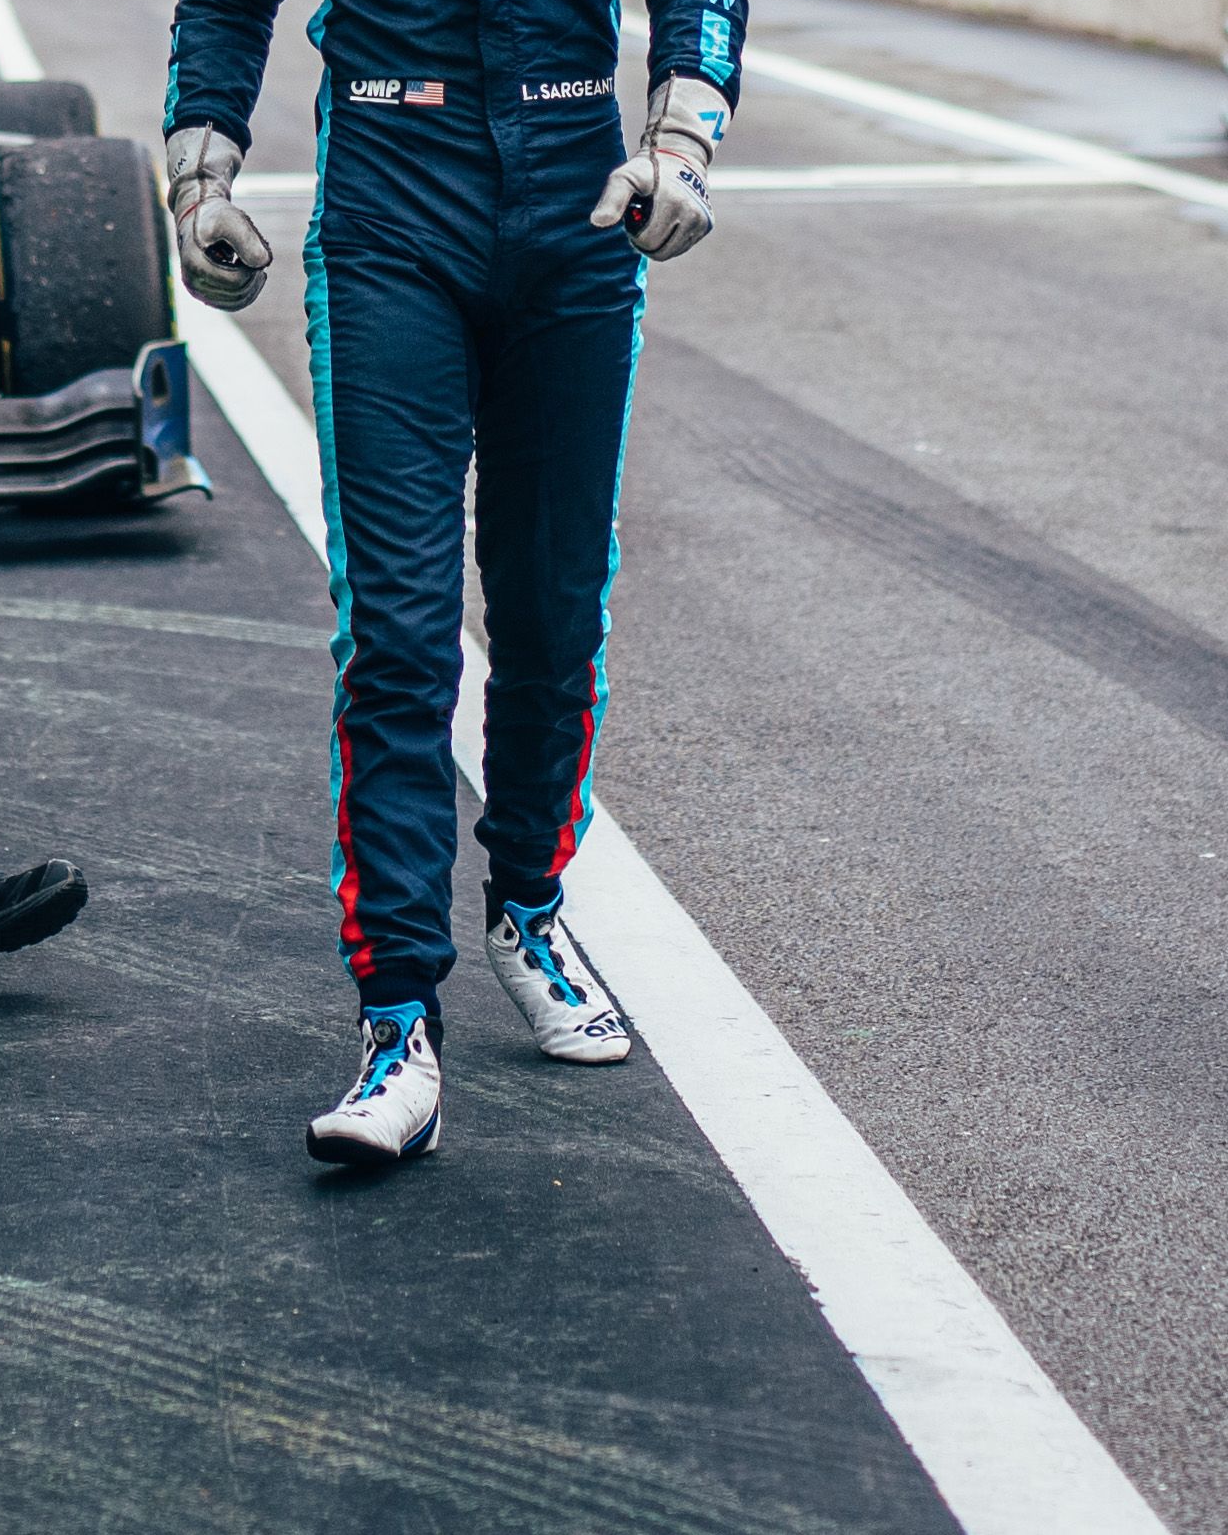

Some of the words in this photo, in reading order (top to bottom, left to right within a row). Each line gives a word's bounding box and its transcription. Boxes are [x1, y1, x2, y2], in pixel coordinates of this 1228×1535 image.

[350, 78, 402, 99] OMP
[522, 83, 539, 101] L.
[539, 76, 614, 101] SARGEANT
